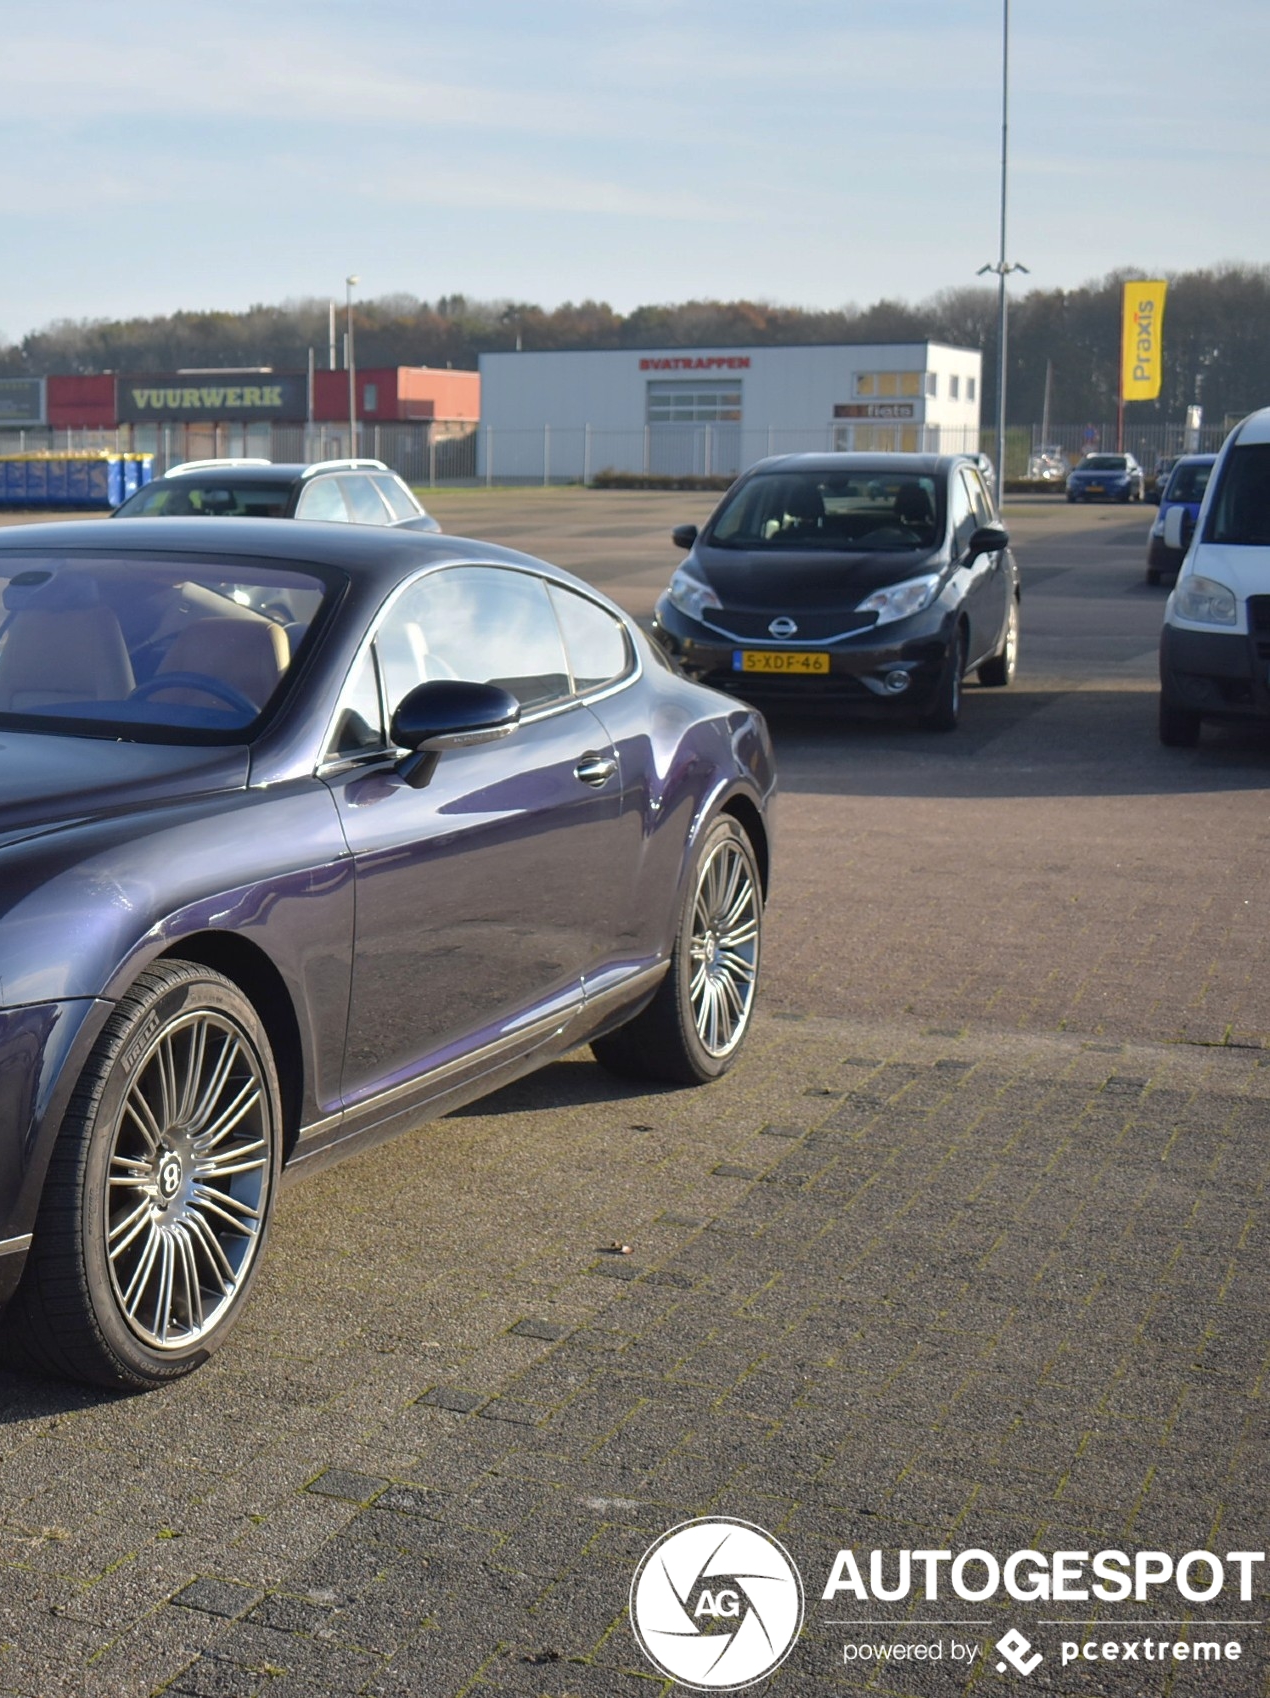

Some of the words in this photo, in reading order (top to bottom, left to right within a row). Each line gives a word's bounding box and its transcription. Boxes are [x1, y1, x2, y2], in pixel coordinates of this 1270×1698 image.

[1133, 300, 1154, 381] Praxis
[132, 386, 282, 409] VUURWERK
[747, 655, 822, 670] 5-XDF-46
[121, 1009, 160, 1073] PIRELLI
